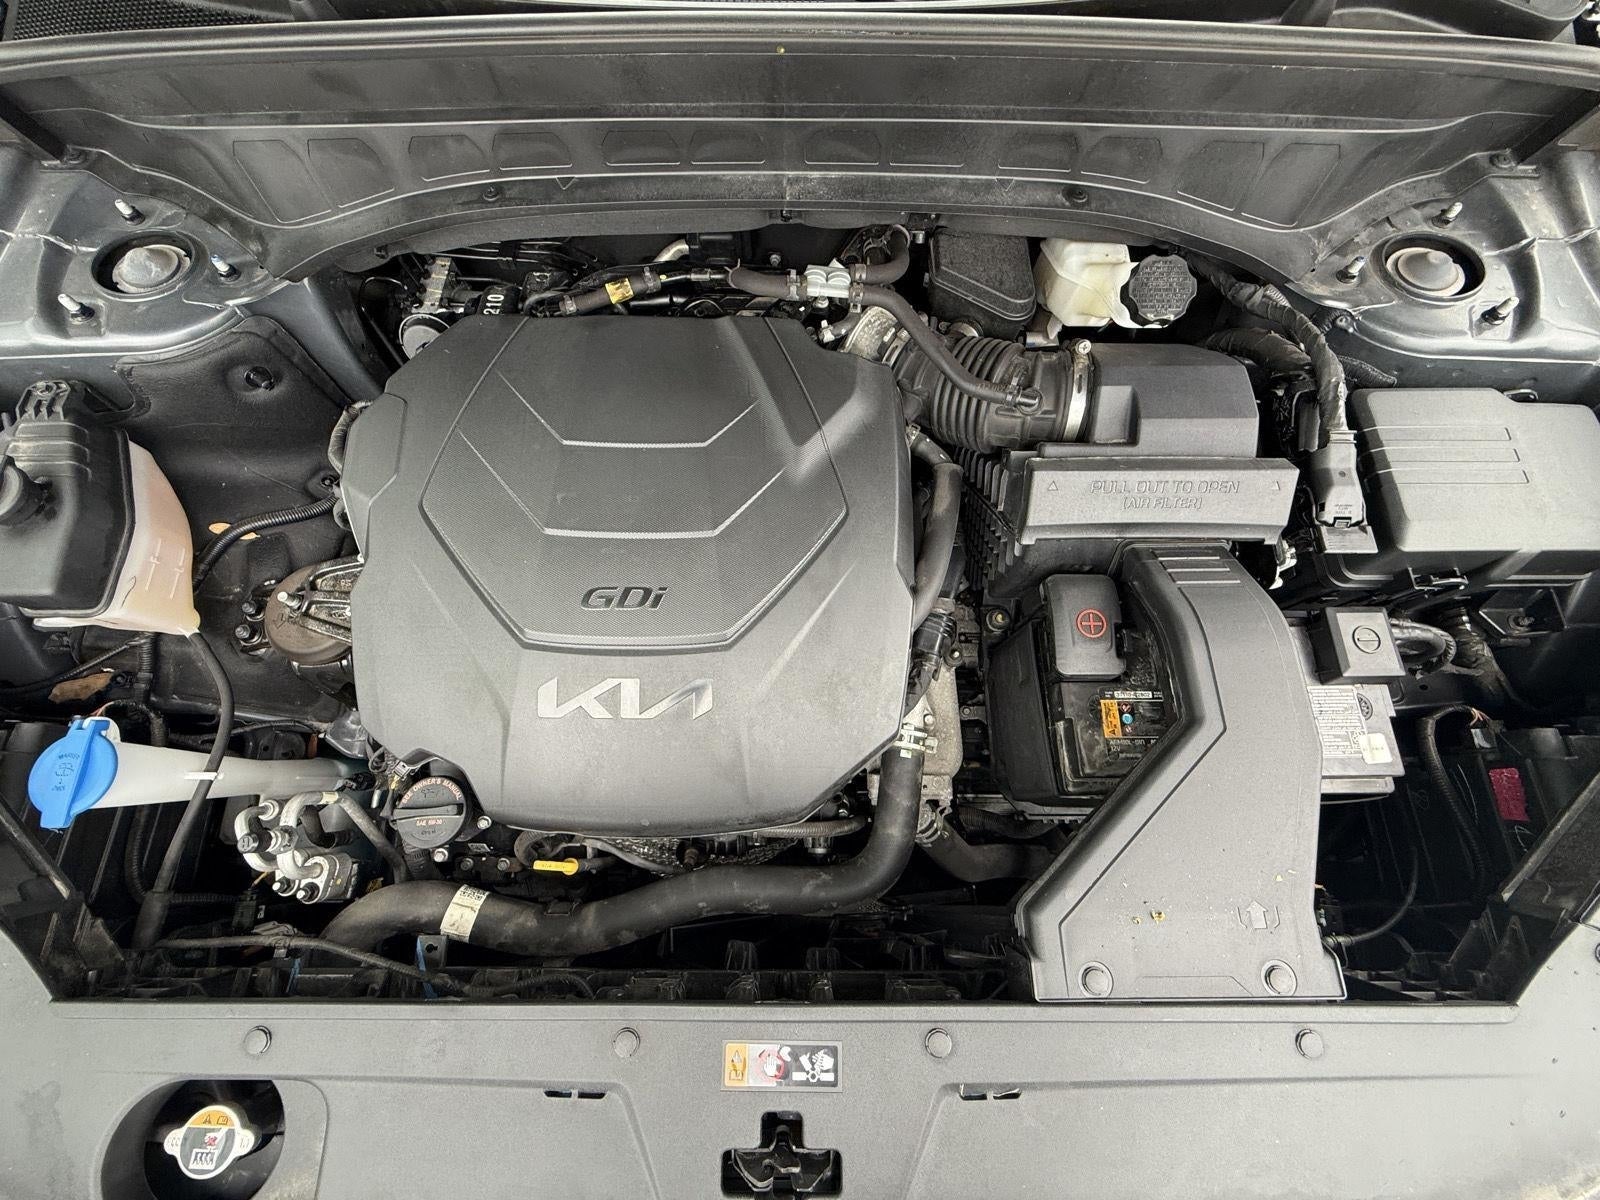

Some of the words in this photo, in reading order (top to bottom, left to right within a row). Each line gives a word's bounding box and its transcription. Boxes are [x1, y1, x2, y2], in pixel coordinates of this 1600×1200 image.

[483, 294, 505, 315] 210
[1090, 480, 1130, 494] PULL
[1136, 480, 1169, 494] OUT
[1175, 480, 1194, 494] TO
[1198, 480, 1240, 494] OPEN
[581, 586, 668, 611] GDi
[537, 677, 713, 720] KIA
[413, 778, 442, 792] OWNER'S
[442, 779, 463, 801] MANUAL
